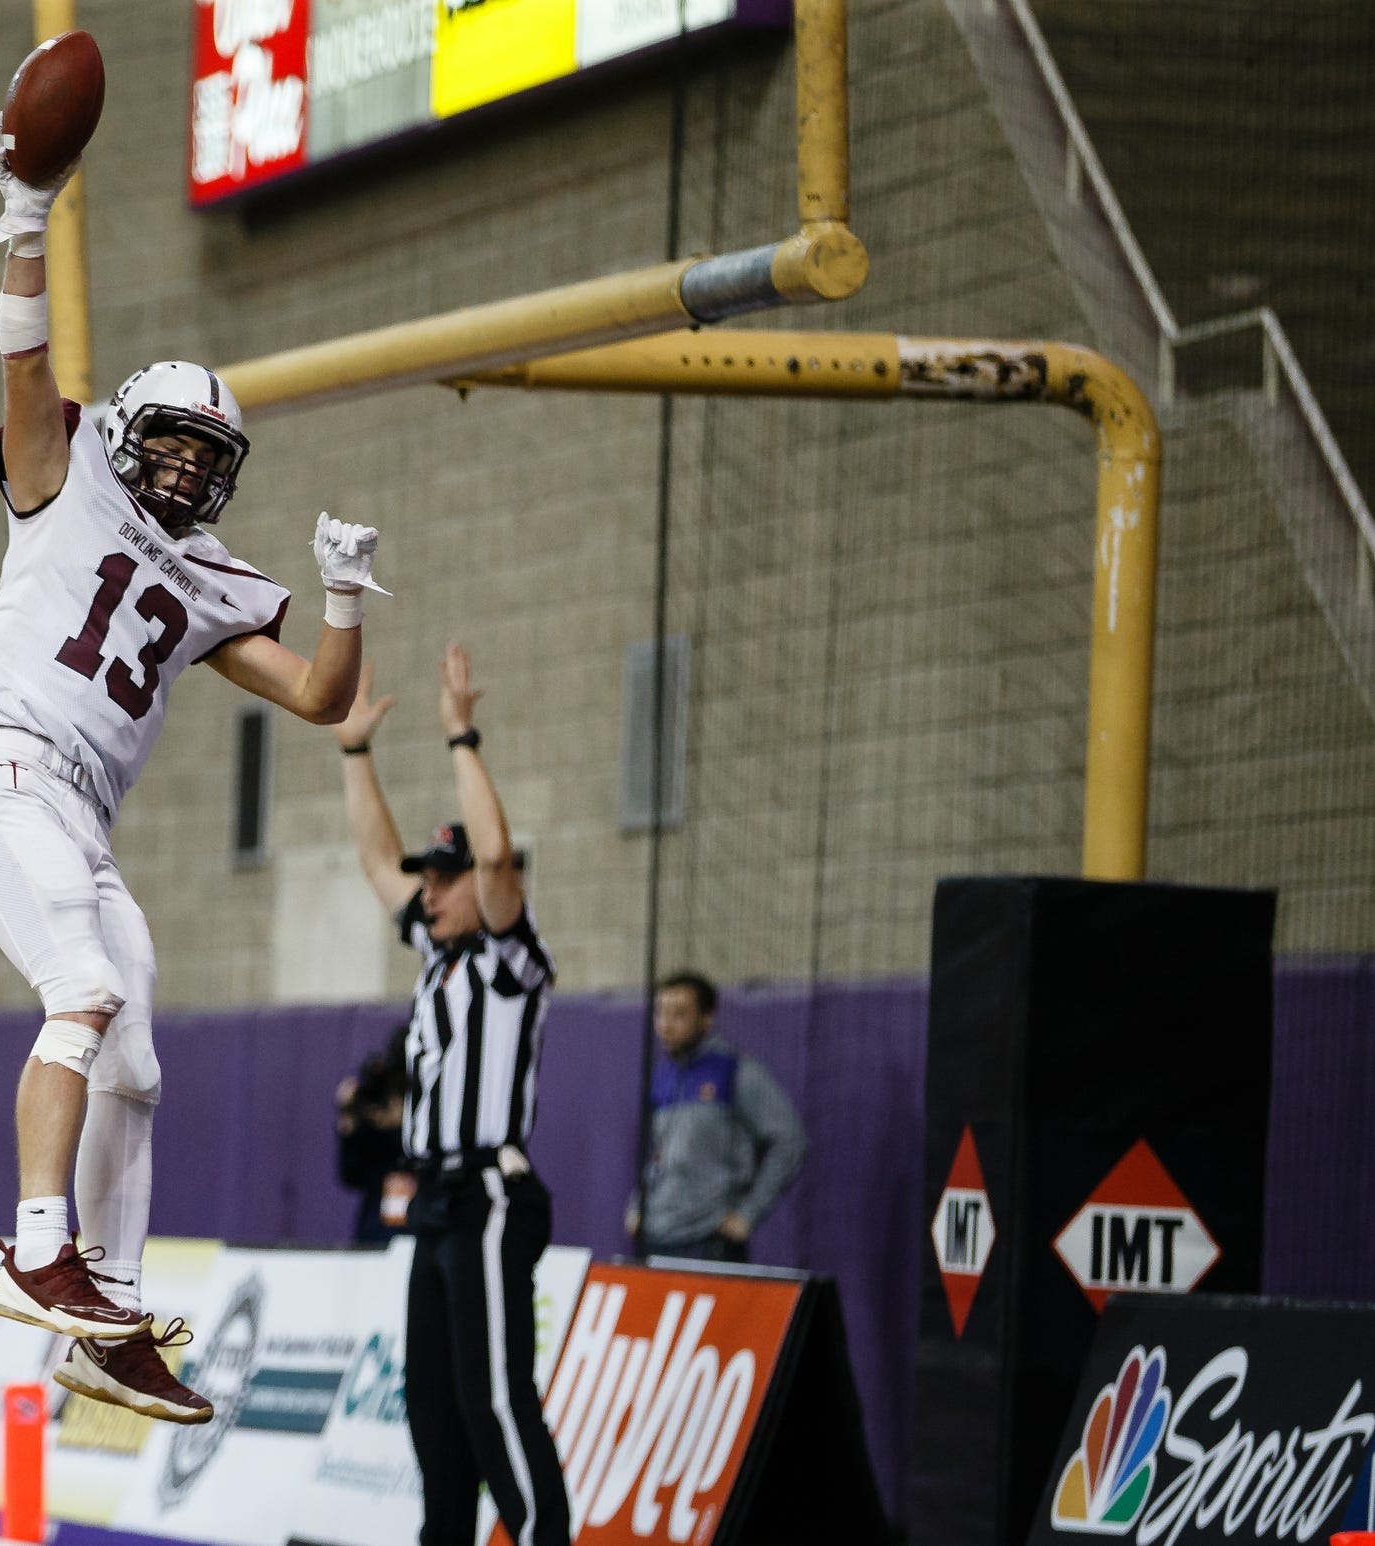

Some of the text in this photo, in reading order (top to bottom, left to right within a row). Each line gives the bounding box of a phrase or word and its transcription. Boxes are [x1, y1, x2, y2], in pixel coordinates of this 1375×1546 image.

[118, 522, 202, 602] DOWLING CATHOLIC
[56, 552, 188, 720] 13
[946, 1198, 982, 1266] IMT
[1090, 1212, 1185, 1287] IMT
[542, 1281, 756, 1542] HyVee
[1136, 1346, 1375, 1546] Sports
